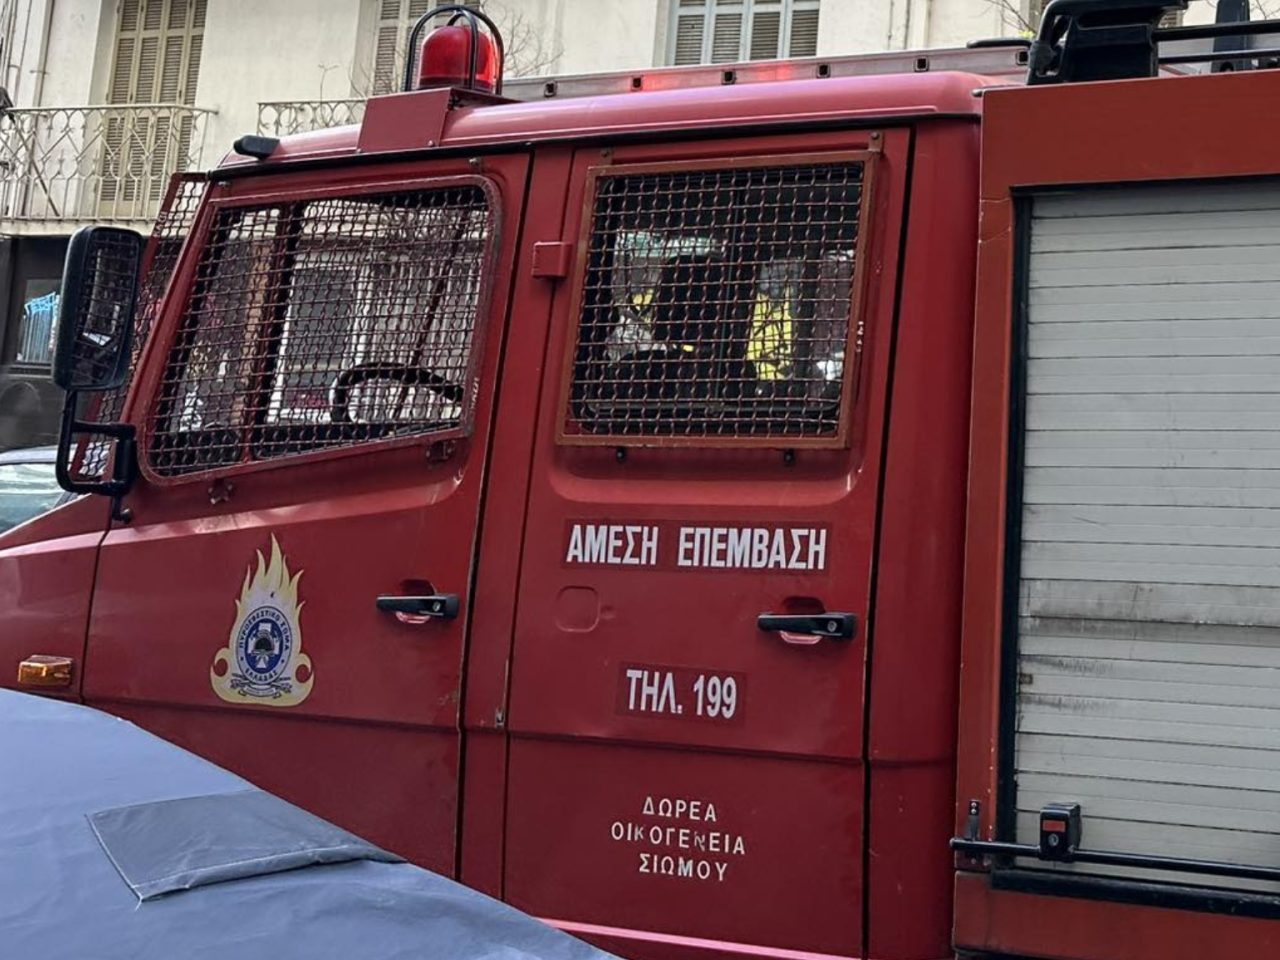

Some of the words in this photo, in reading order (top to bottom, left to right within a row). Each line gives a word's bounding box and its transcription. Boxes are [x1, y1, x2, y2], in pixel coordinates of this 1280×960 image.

[566, 524, 659, 566] ΑΜΕΣΗ
[677, 526, 827, 570] ΕΠΕΜΒΑΣΗ
[626, 669, 683, 714] ΤΗΛ.
[693, 674, 737, 719] 199
[642, 796, 717, 822] ΔΩΡΕΑ
[639, 853, 728, 882] ΣΙΩΜΟΥ
